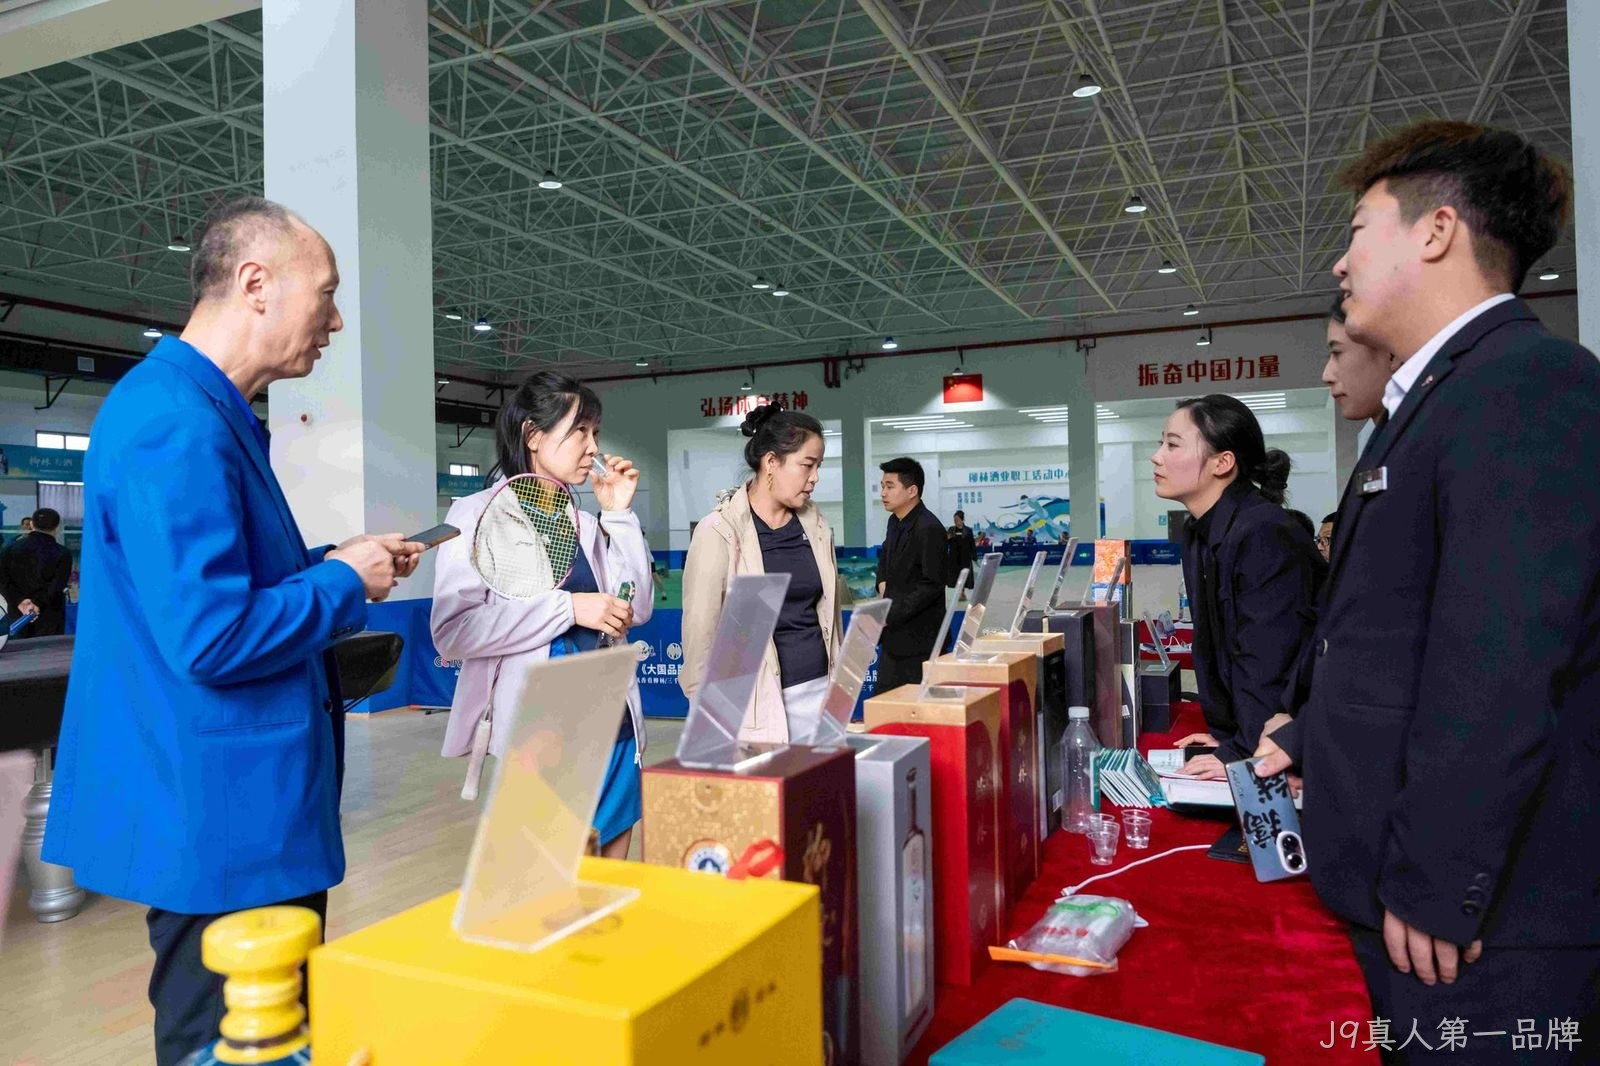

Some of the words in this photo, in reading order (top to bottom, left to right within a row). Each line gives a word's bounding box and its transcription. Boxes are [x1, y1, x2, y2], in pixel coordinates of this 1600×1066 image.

[1138, 355, 1281, 386] 振奋中国力量
